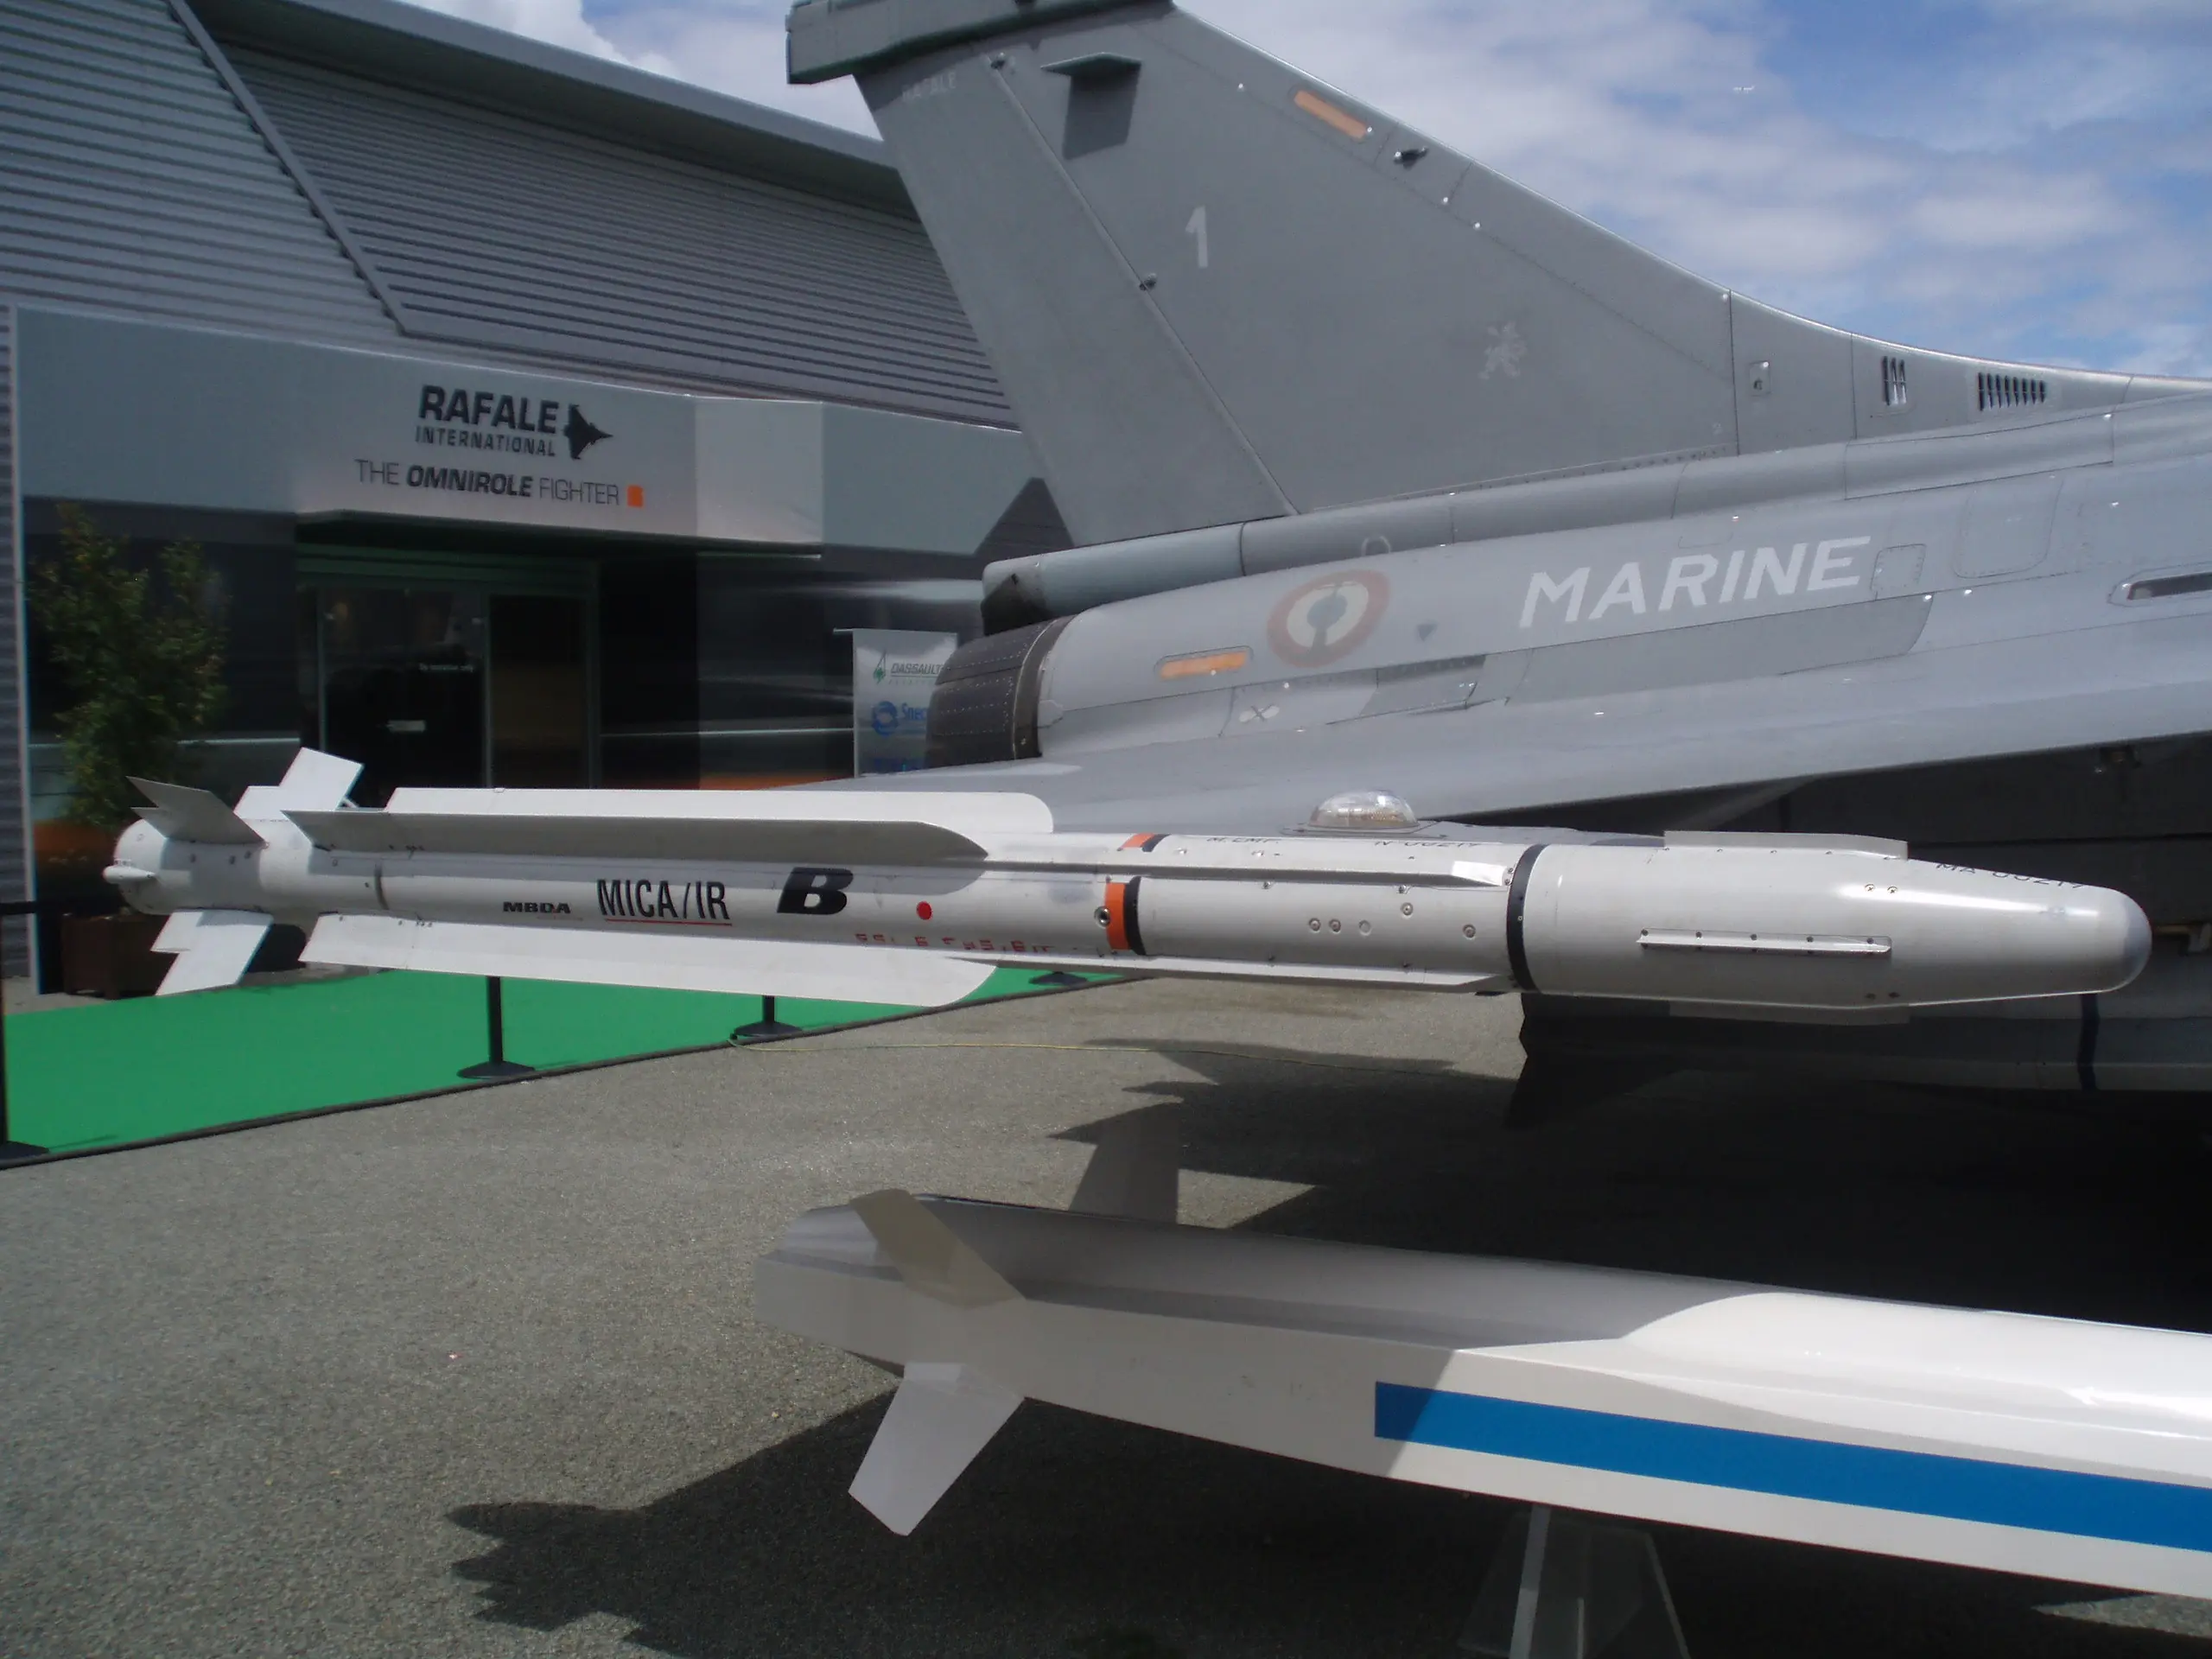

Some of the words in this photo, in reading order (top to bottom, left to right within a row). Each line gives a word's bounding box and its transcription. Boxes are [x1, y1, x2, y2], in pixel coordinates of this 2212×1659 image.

[1185, 205, 1209, 269] 1
[418, 385, 559, 434] RAFALE
[415, 425, 556, 458] INTERNATIONAL
[354, 458, 400, 486] THE
[405, 464, 533, 498] OMNIROLE
[539, 477, 620, 505] FIGHTER
[1518, 536, 1871, 628] MARINE
[891, 663, 944, 675] DASSAULT
[503, 901, 571, 914] MBDA
[597, 879, 730, 920] MICA/IR
[778, 867, 855, 916] B
